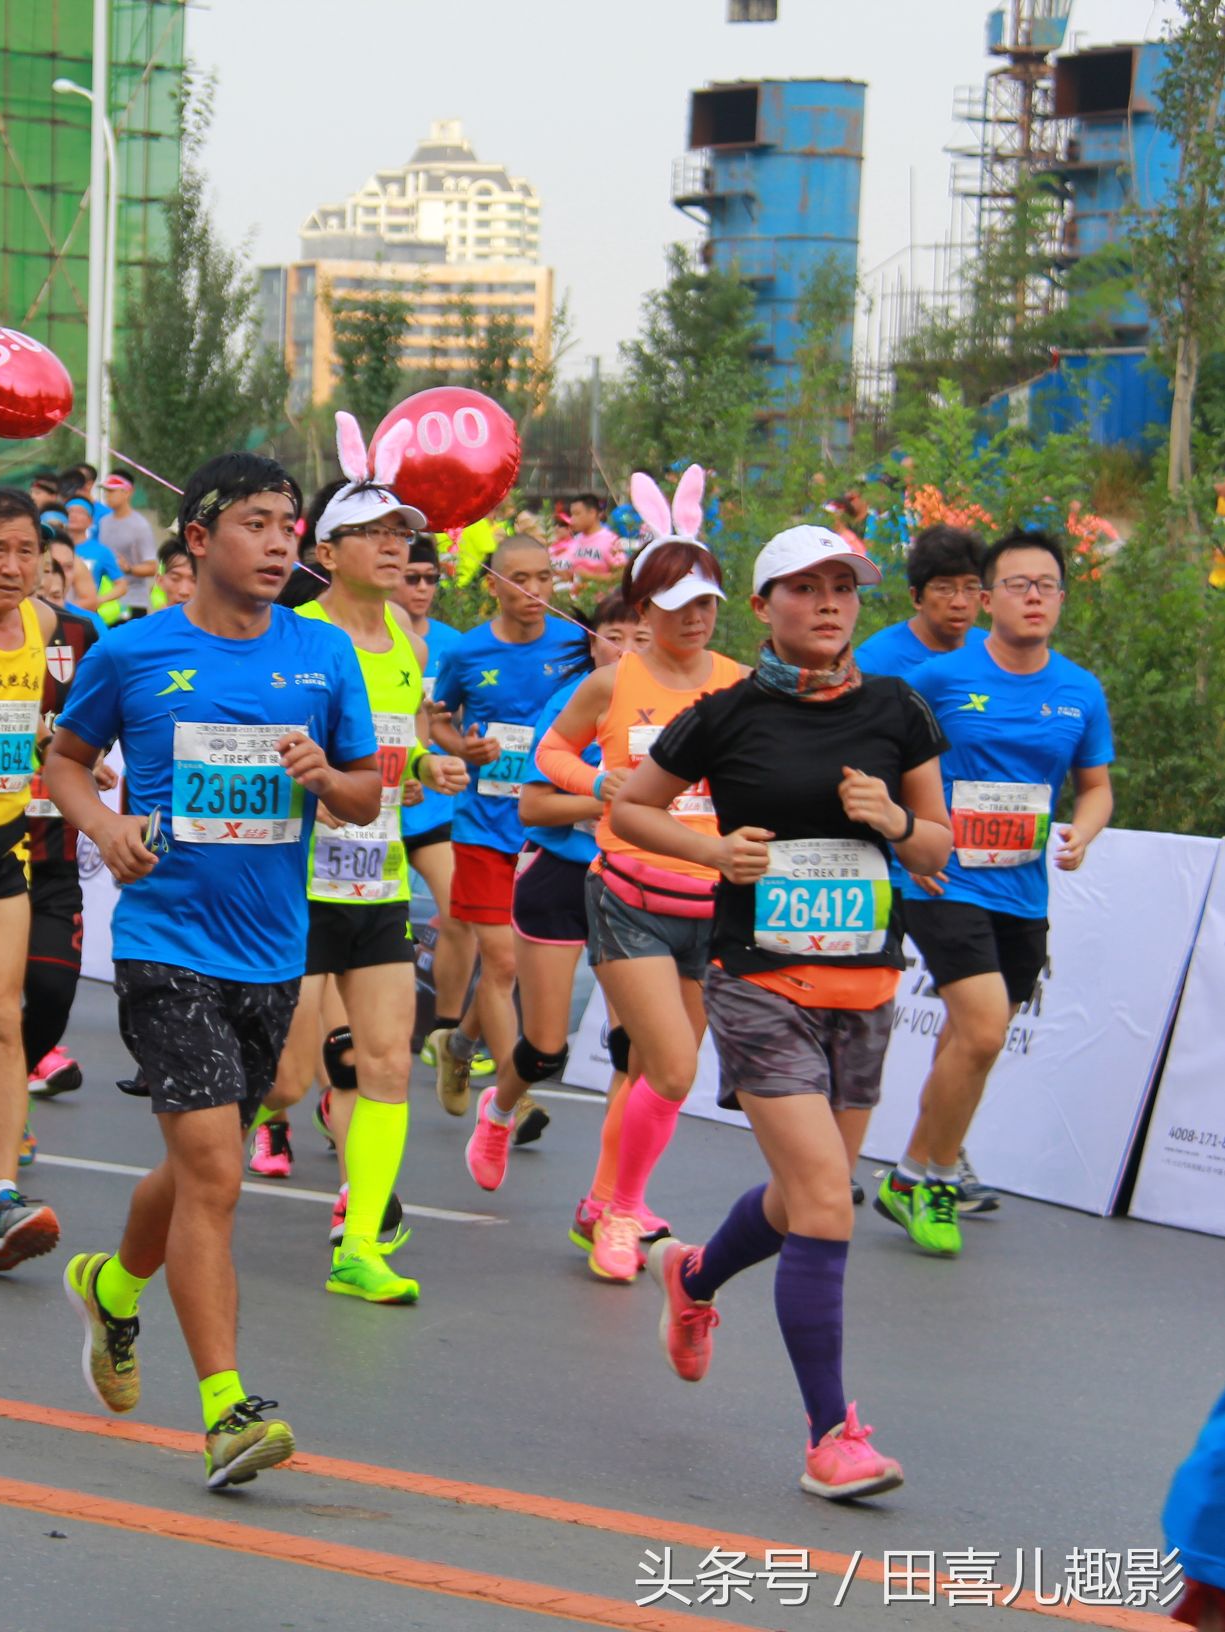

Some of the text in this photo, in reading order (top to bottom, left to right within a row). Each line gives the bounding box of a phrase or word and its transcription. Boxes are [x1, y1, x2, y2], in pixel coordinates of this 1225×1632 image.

[209, 752, 252, 764] C-TREK
[186, 771, 280, 815] 23631
[961, 816, 1026, 848] 10974
[327, 845, 382, 879] 5:00
[792, 868, 834, 878] C-TREK
[766, 886, 865, 928] 26412
